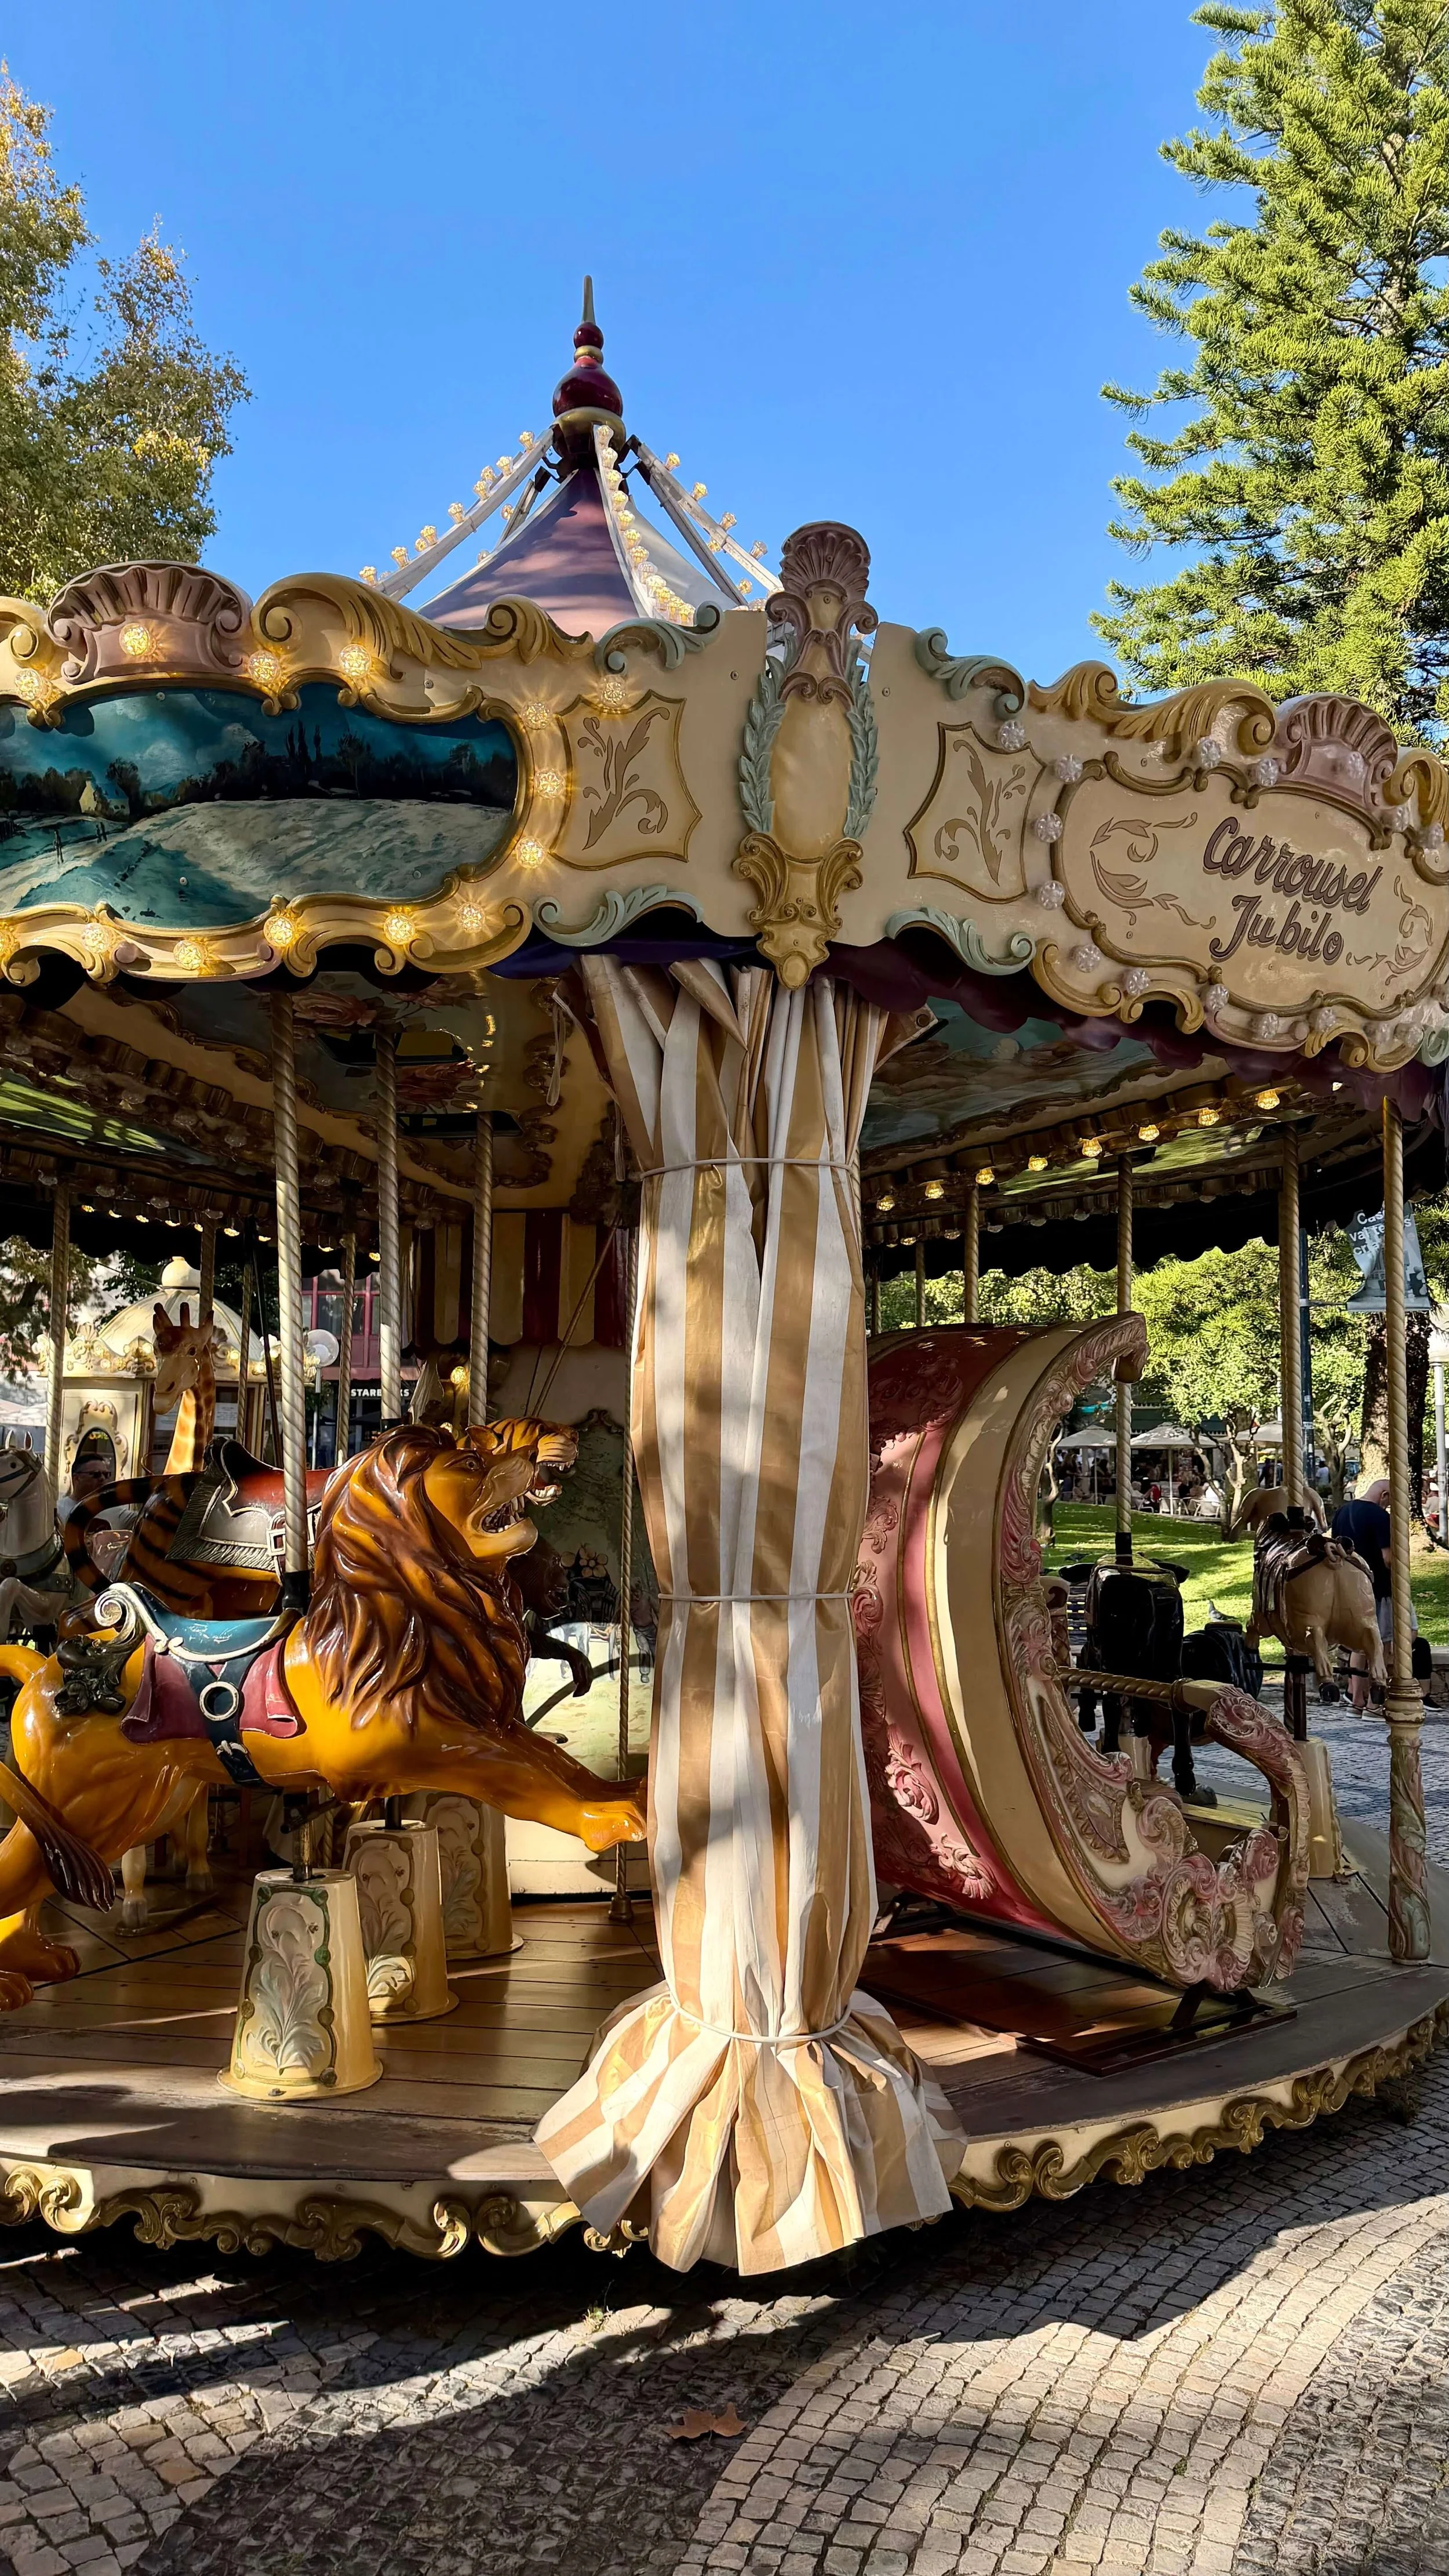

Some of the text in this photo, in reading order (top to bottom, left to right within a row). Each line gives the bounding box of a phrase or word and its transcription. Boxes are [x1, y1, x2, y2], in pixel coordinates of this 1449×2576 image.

[1203, 817, 1383, 914] Carrousel
[1209, 895, 1344, 962] Jubilo
[351, 1389, 409, 1397] STARBS
